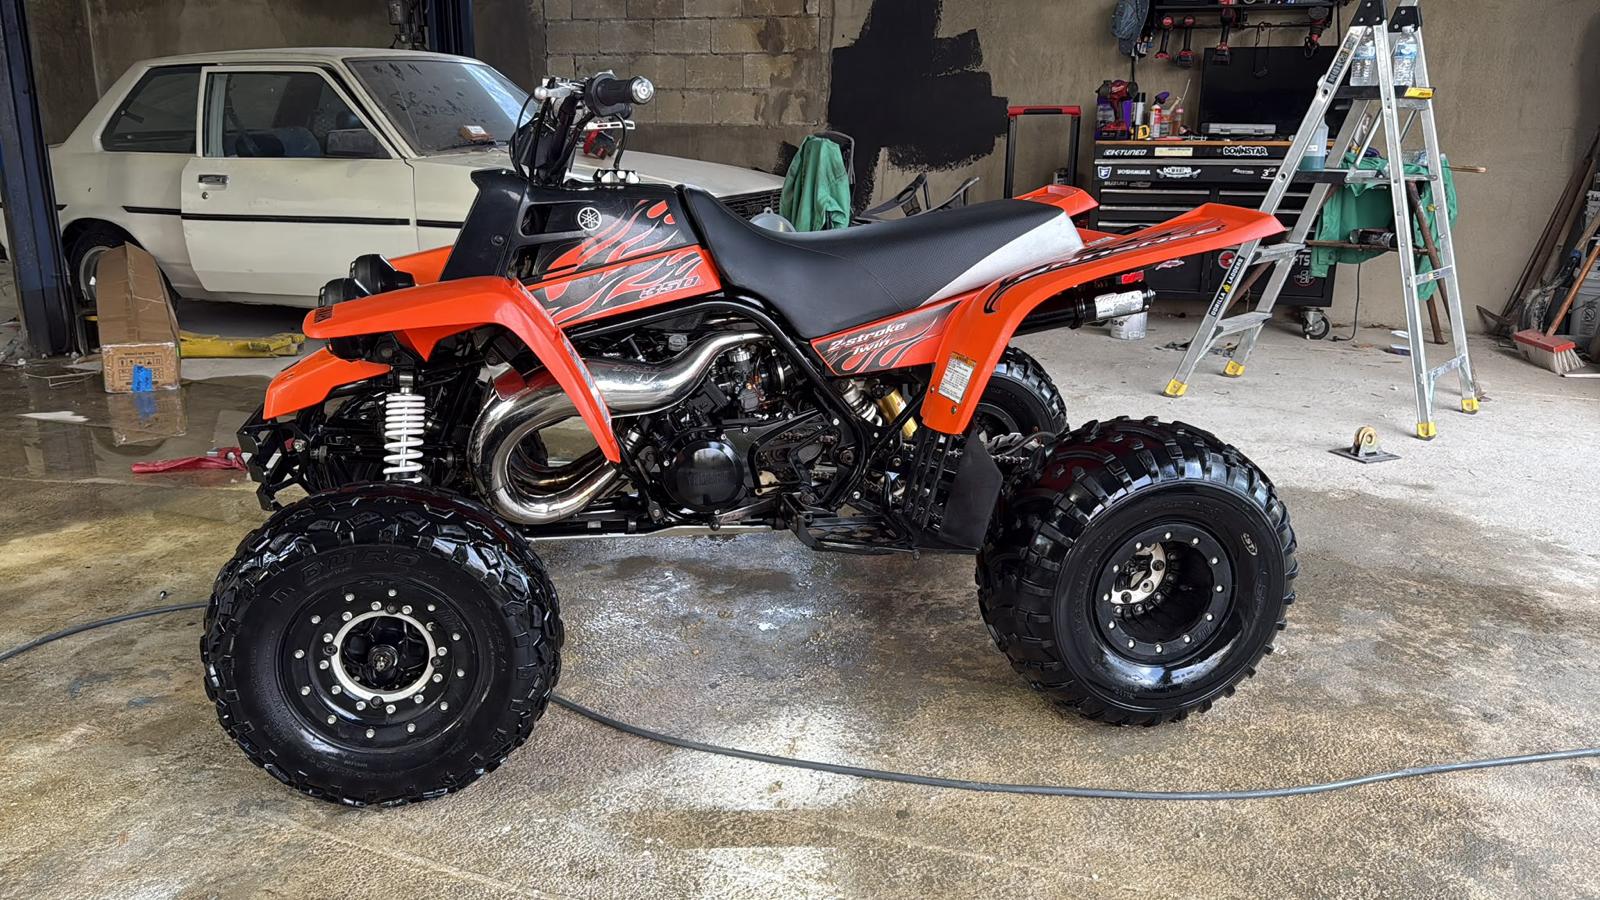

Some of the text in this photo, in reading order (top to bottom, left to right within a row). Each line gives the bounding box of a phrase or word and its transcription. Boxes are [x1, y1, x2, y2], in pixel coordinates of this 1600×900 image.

[1223, 145, 1268, 156] DOWNSTAR
[1211, 257, 1243, 316] GORILLA LADDERS
[852, 337, 892, 356] Twin
